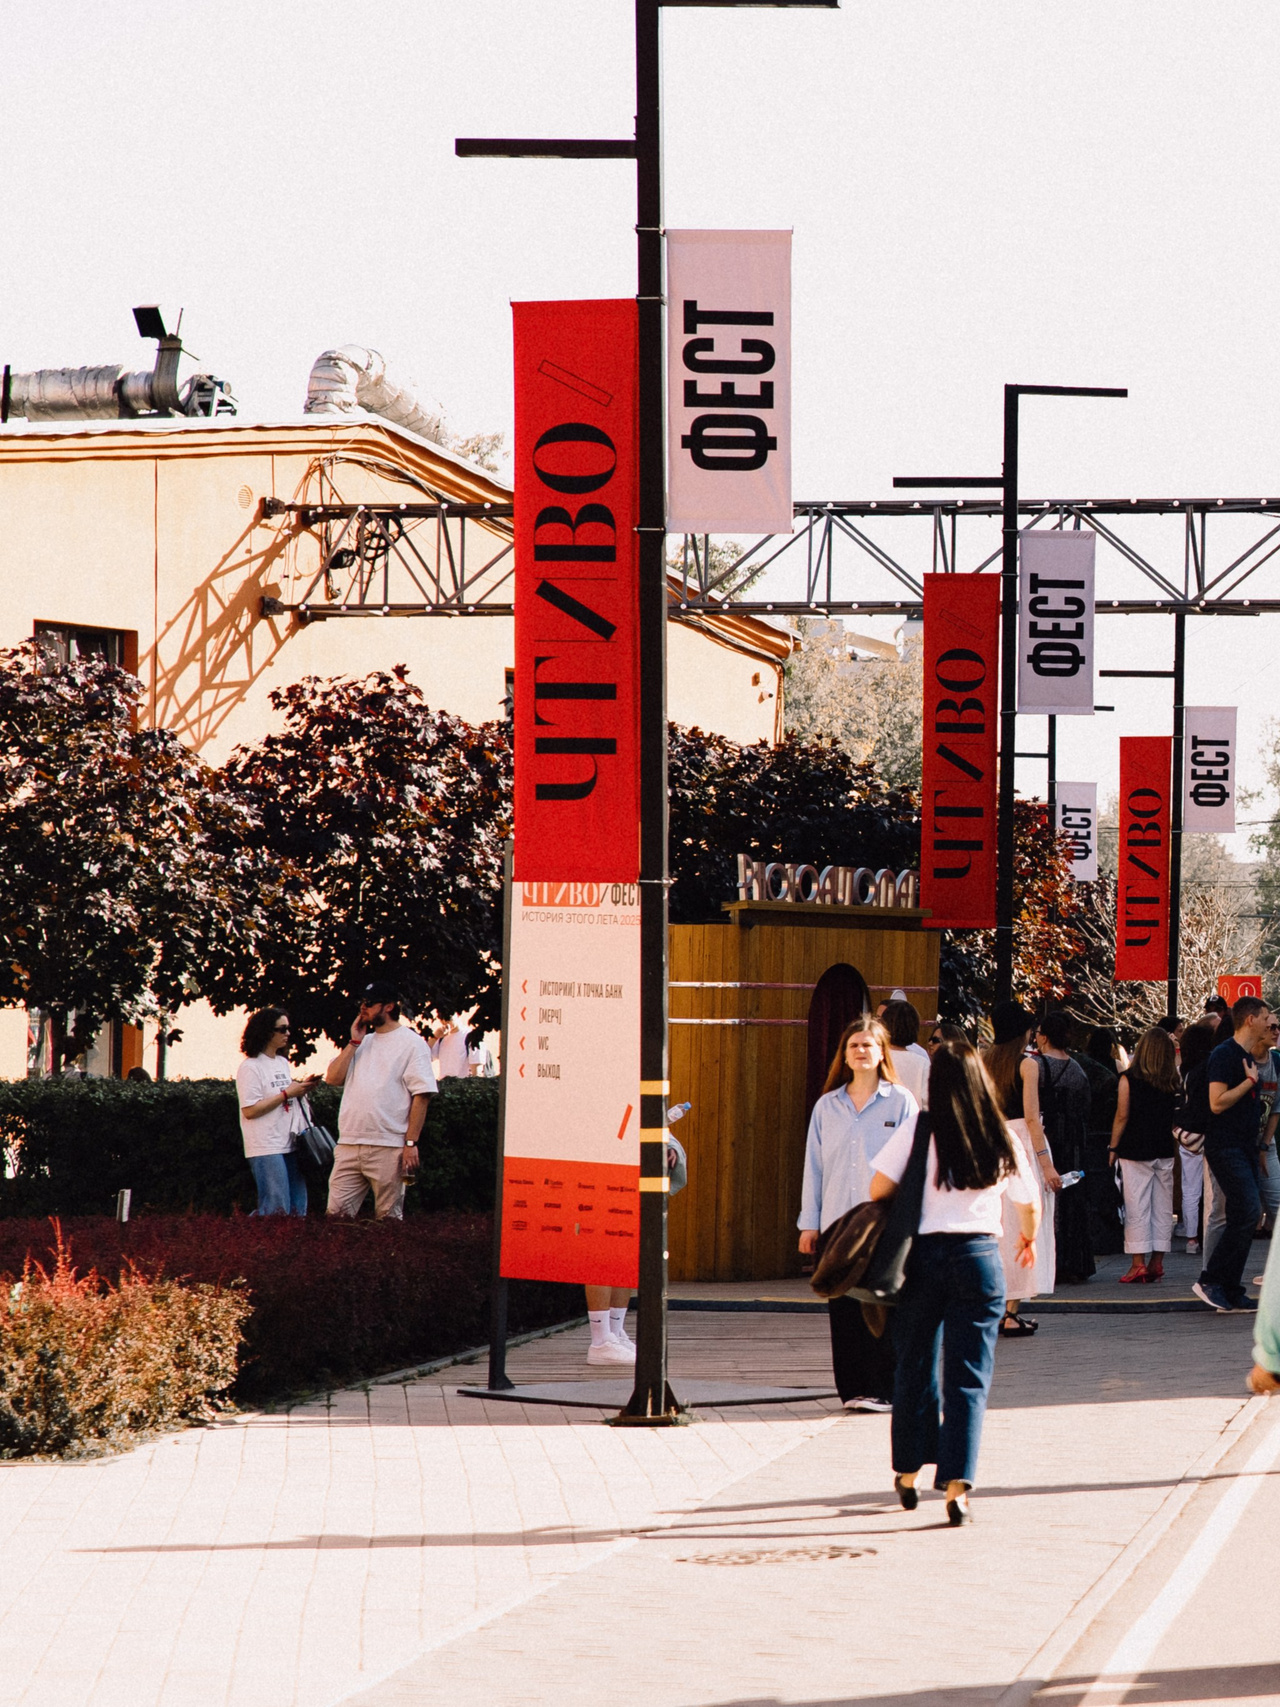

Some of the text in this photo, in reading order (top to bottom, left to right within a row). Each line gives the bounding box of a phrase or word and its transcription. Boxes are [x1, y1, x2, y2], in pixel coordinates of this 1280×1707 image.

[681, 300, 777, 471] ФЕСТ
[1027, 573, 1086, 677] ФЕСТ
[1189, 735, 1230, 807] ФЕСТ
[522, 911, 641, 926] ИСТОРИЯ ЭТОГО ЛЕТА 2025
[583, 983, 604, 998] ТОЧКА
[605, 984, 623, 999] БАНК
[538, 1036, 549, 1050] WC
[537, 1063, 560, 1080] ВЫХОД
